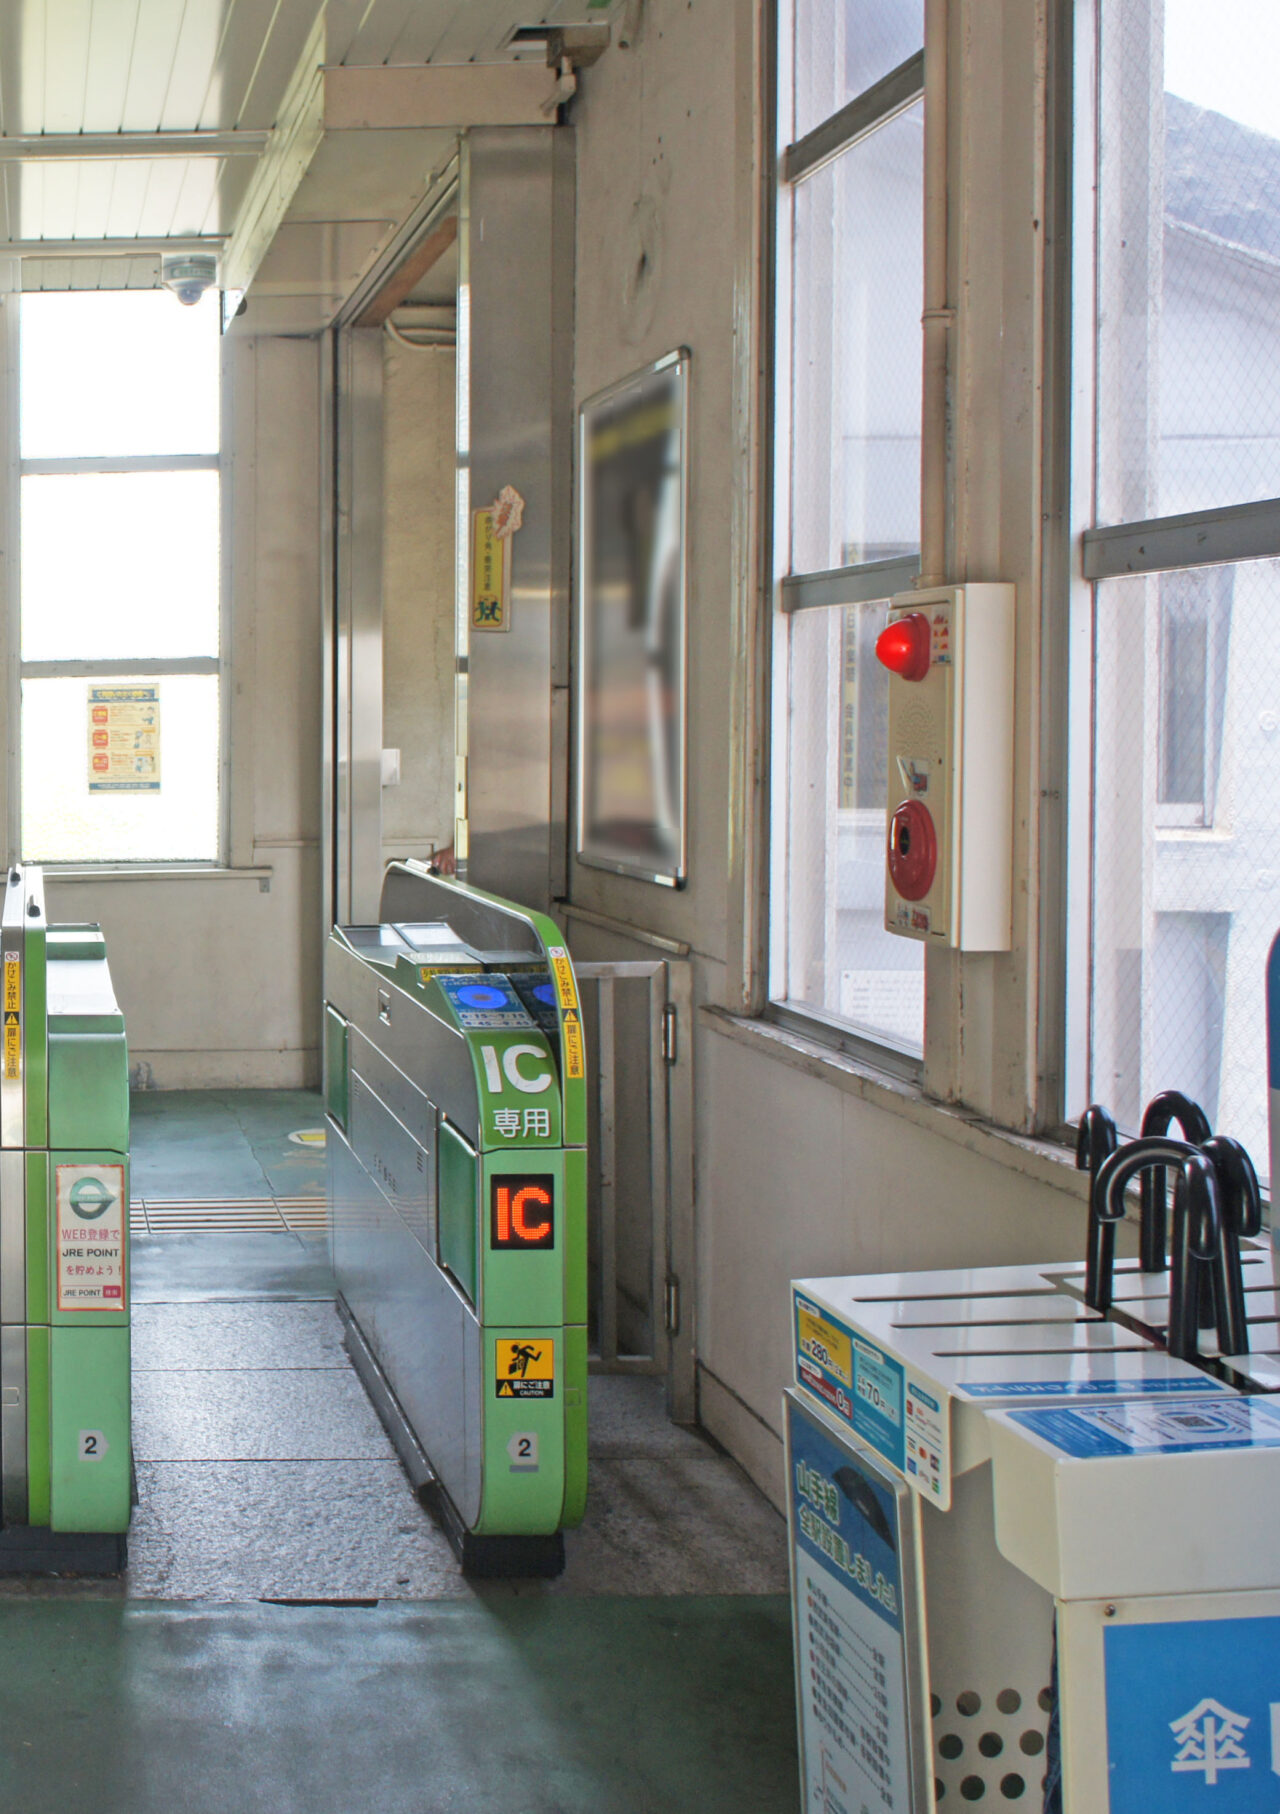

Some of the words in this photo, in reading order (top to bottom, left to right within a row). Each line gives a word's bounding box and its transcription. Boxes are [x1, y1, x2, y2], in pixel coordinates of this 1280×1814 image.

[8, 962, 17, 1010] かけこみ禁止
[480, 1044, 553, 1094] IC
[492, 1107, 551, 1138] 専用
[496, 1187, 551, 1240] IC
[61, 1228, 120, 1240] WEB登録で
[62, 1248, 83, 1257] JRE
[87, 1248, 120, 1257] POINT
[513, 1380, 551, 1390] 扉にご注意
[84, 1436, 97, 1454] 2
[518, 1438, 532, 1456] 2
[796, 1458, 841, 1527] 山手線
